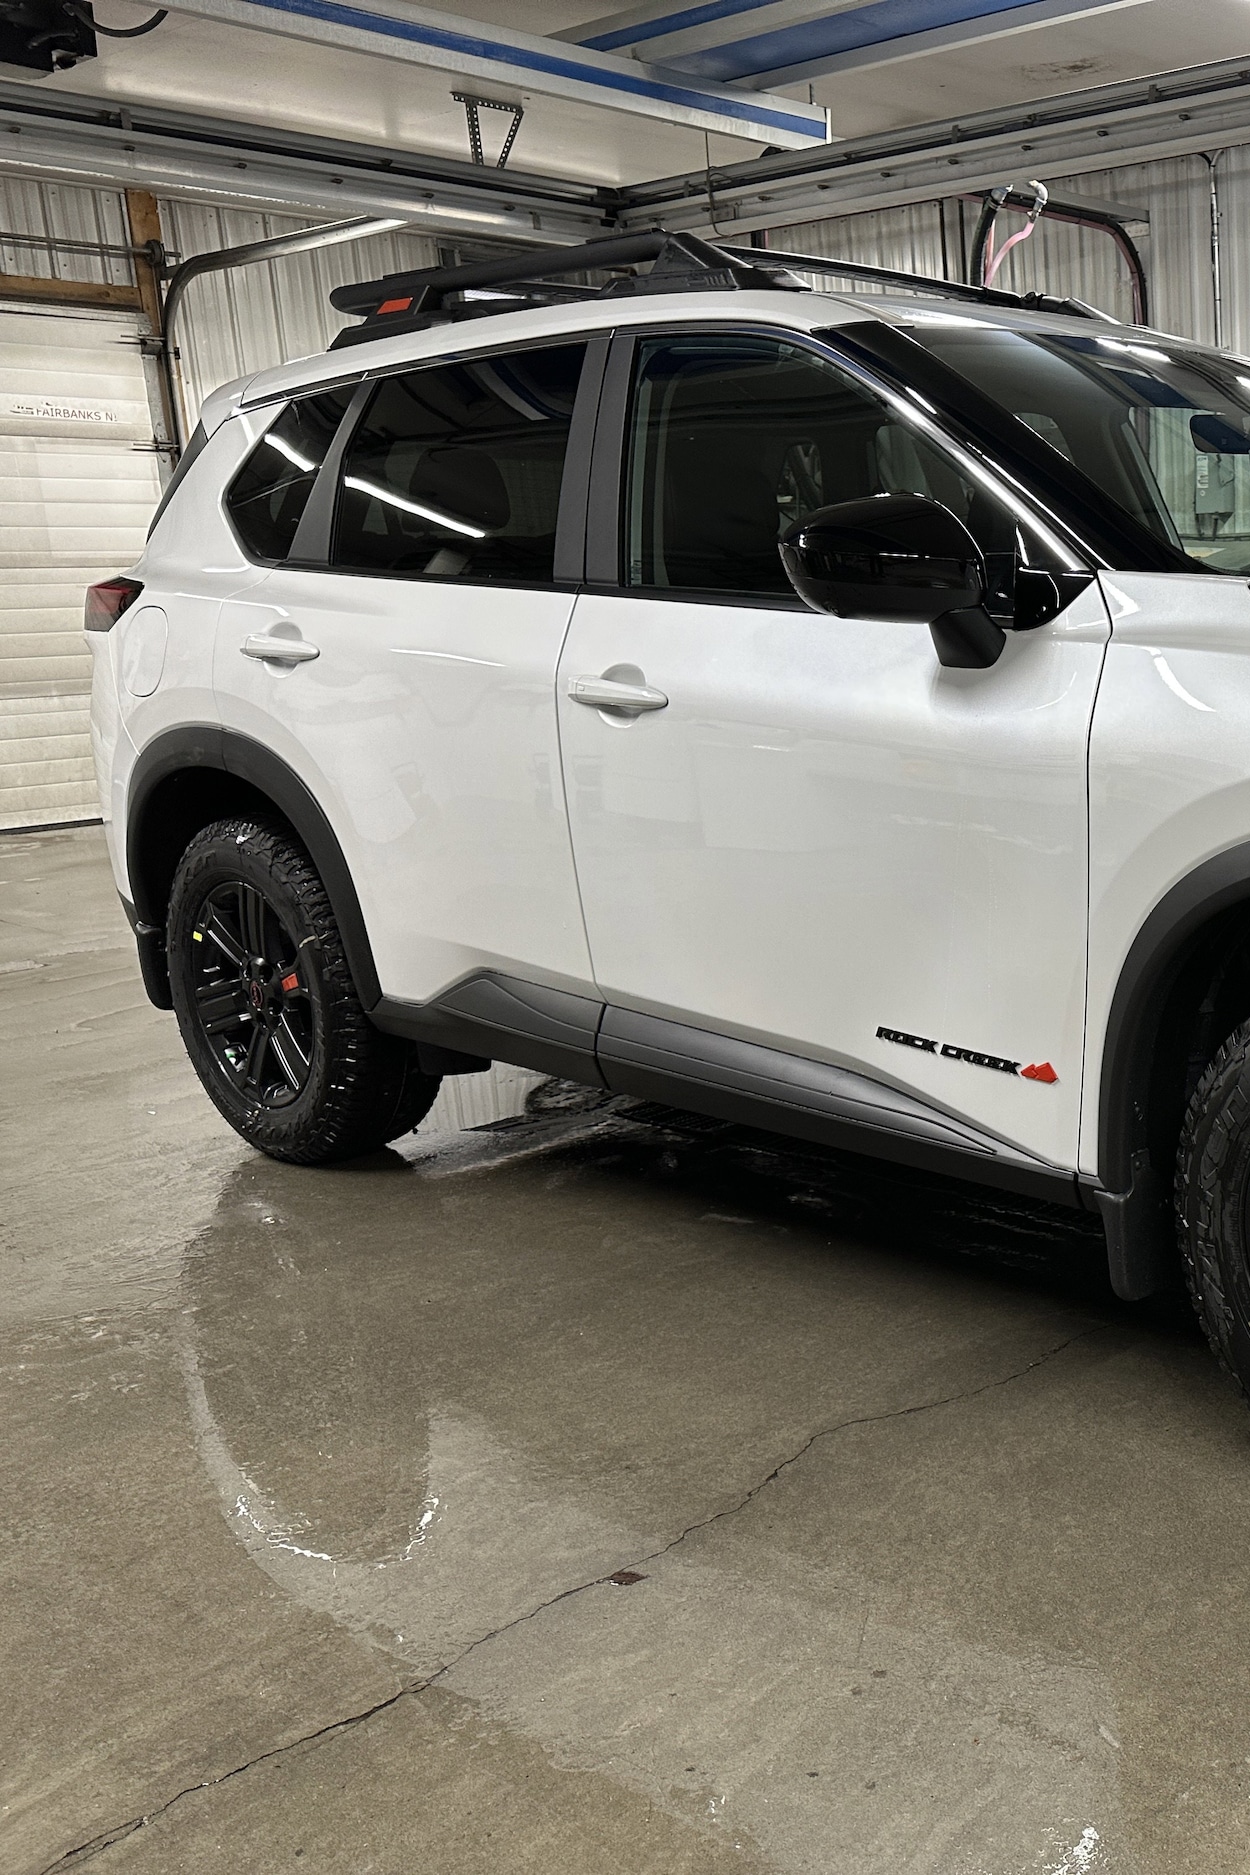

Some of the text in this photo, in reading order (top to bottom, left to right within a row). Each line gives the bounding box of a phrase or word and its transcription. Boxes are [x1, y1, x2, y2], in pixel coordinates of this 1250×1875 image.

[36, 407, 102, 421] FAIRBANKS
[876, 1026, 1022, 1075] ROCK CREEK
